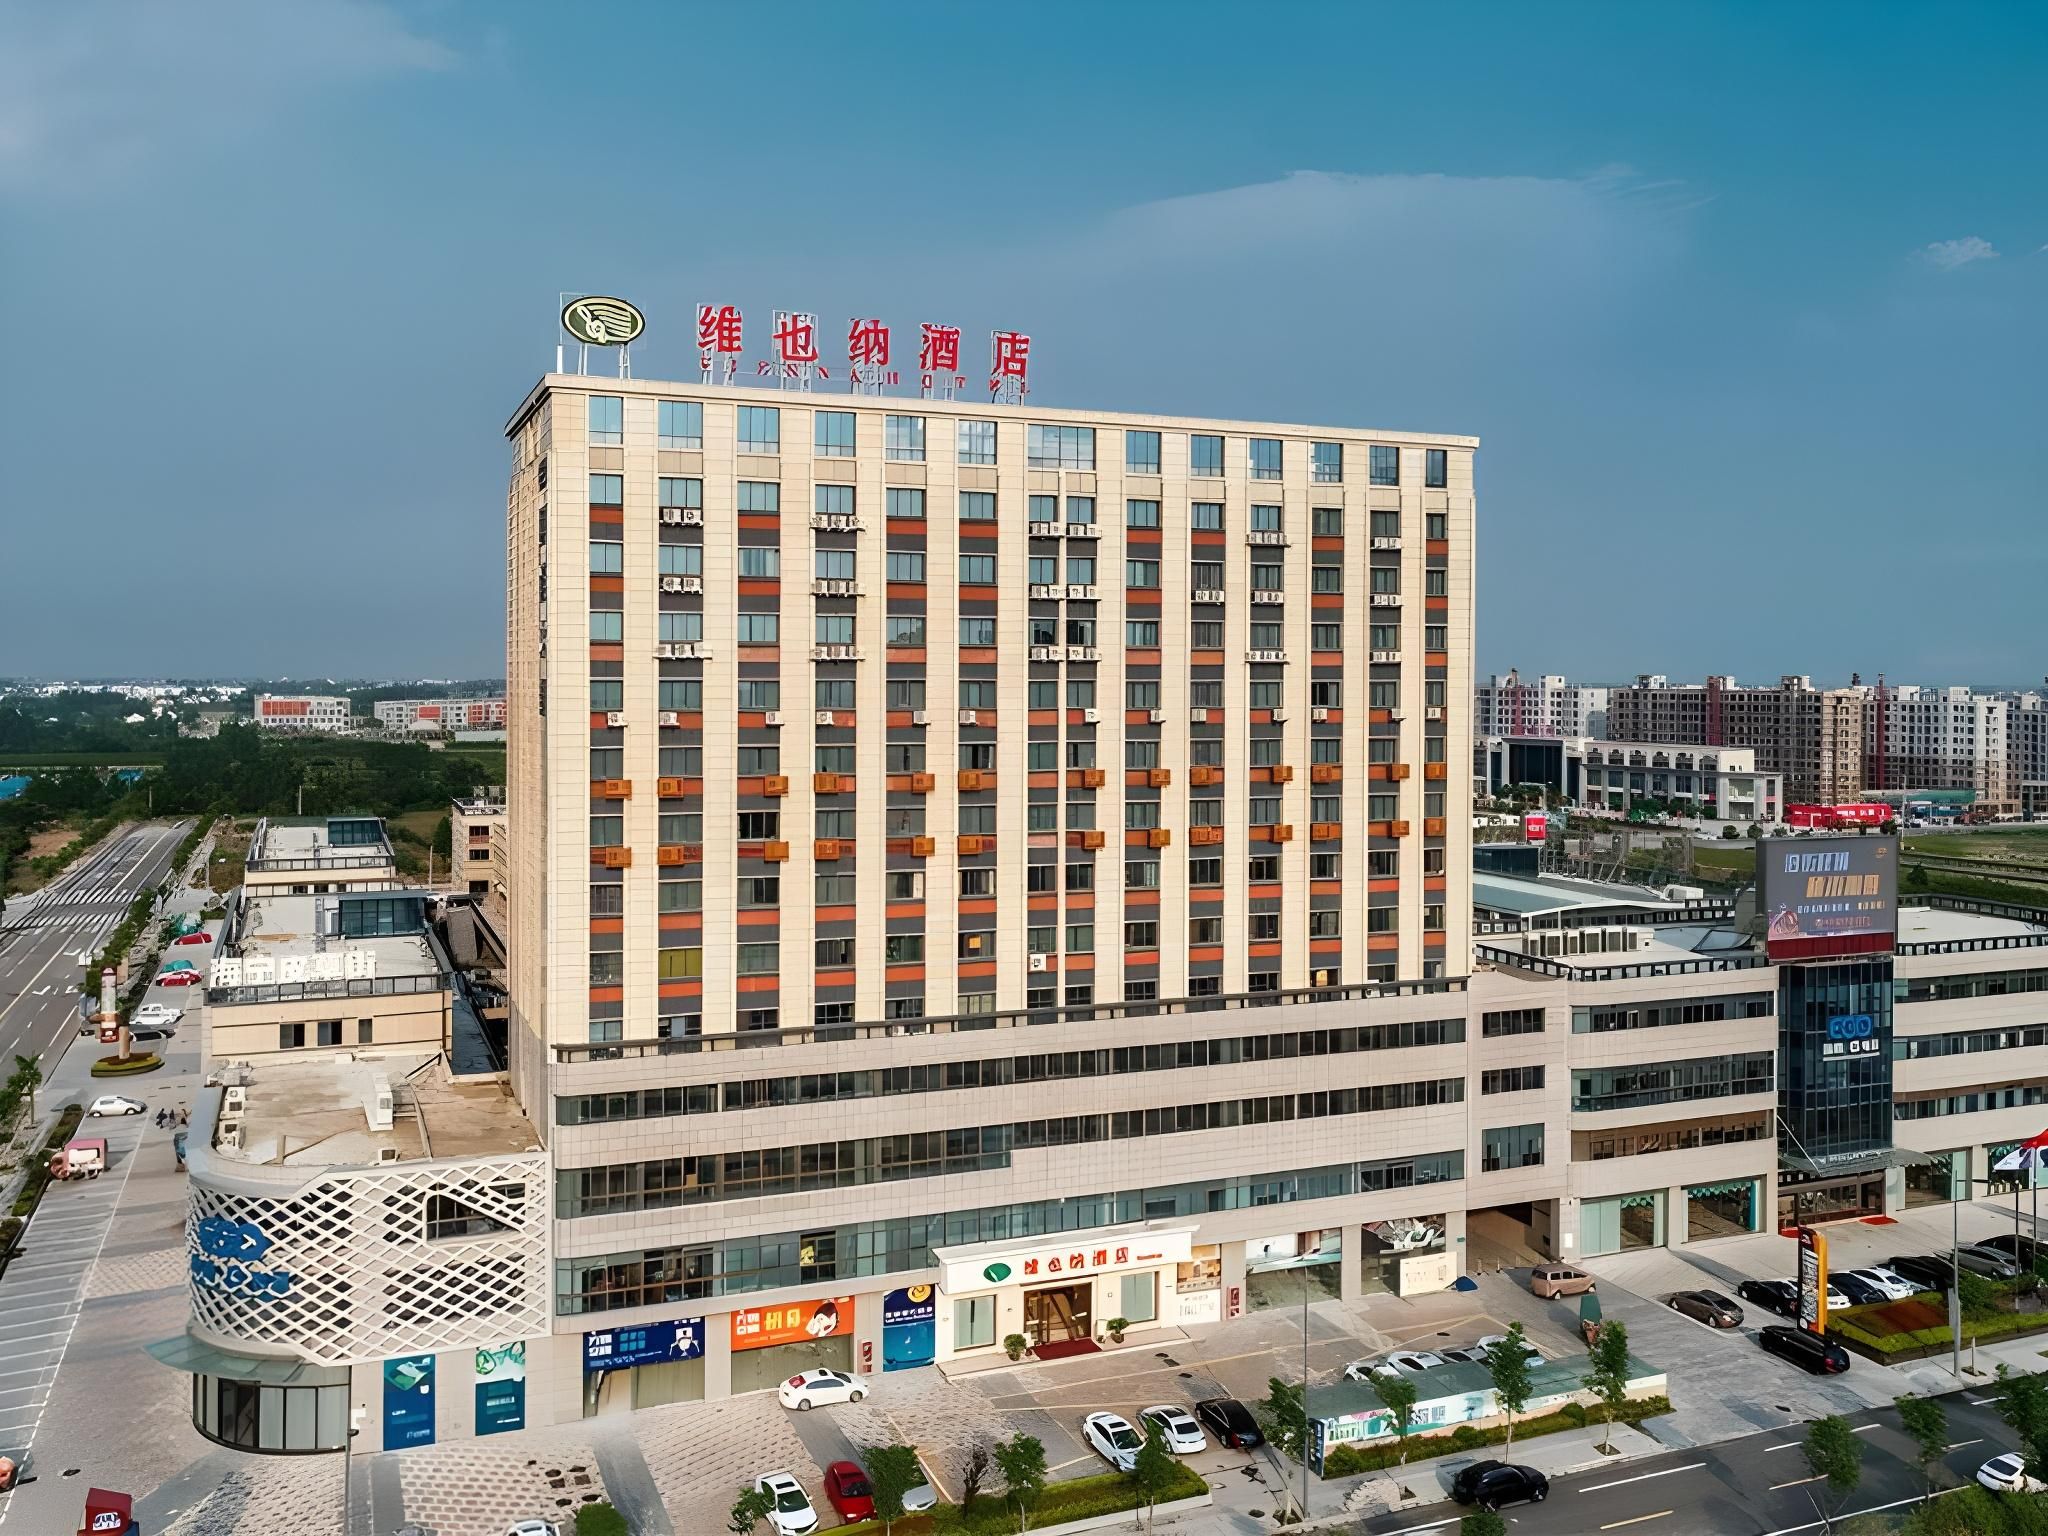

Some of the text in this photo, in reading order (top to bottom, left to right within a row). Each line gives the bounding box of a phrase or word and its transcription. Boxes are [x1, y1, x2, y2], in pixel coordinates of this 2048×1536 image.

[697, 305, 1031, 376] 维也纳酒店
